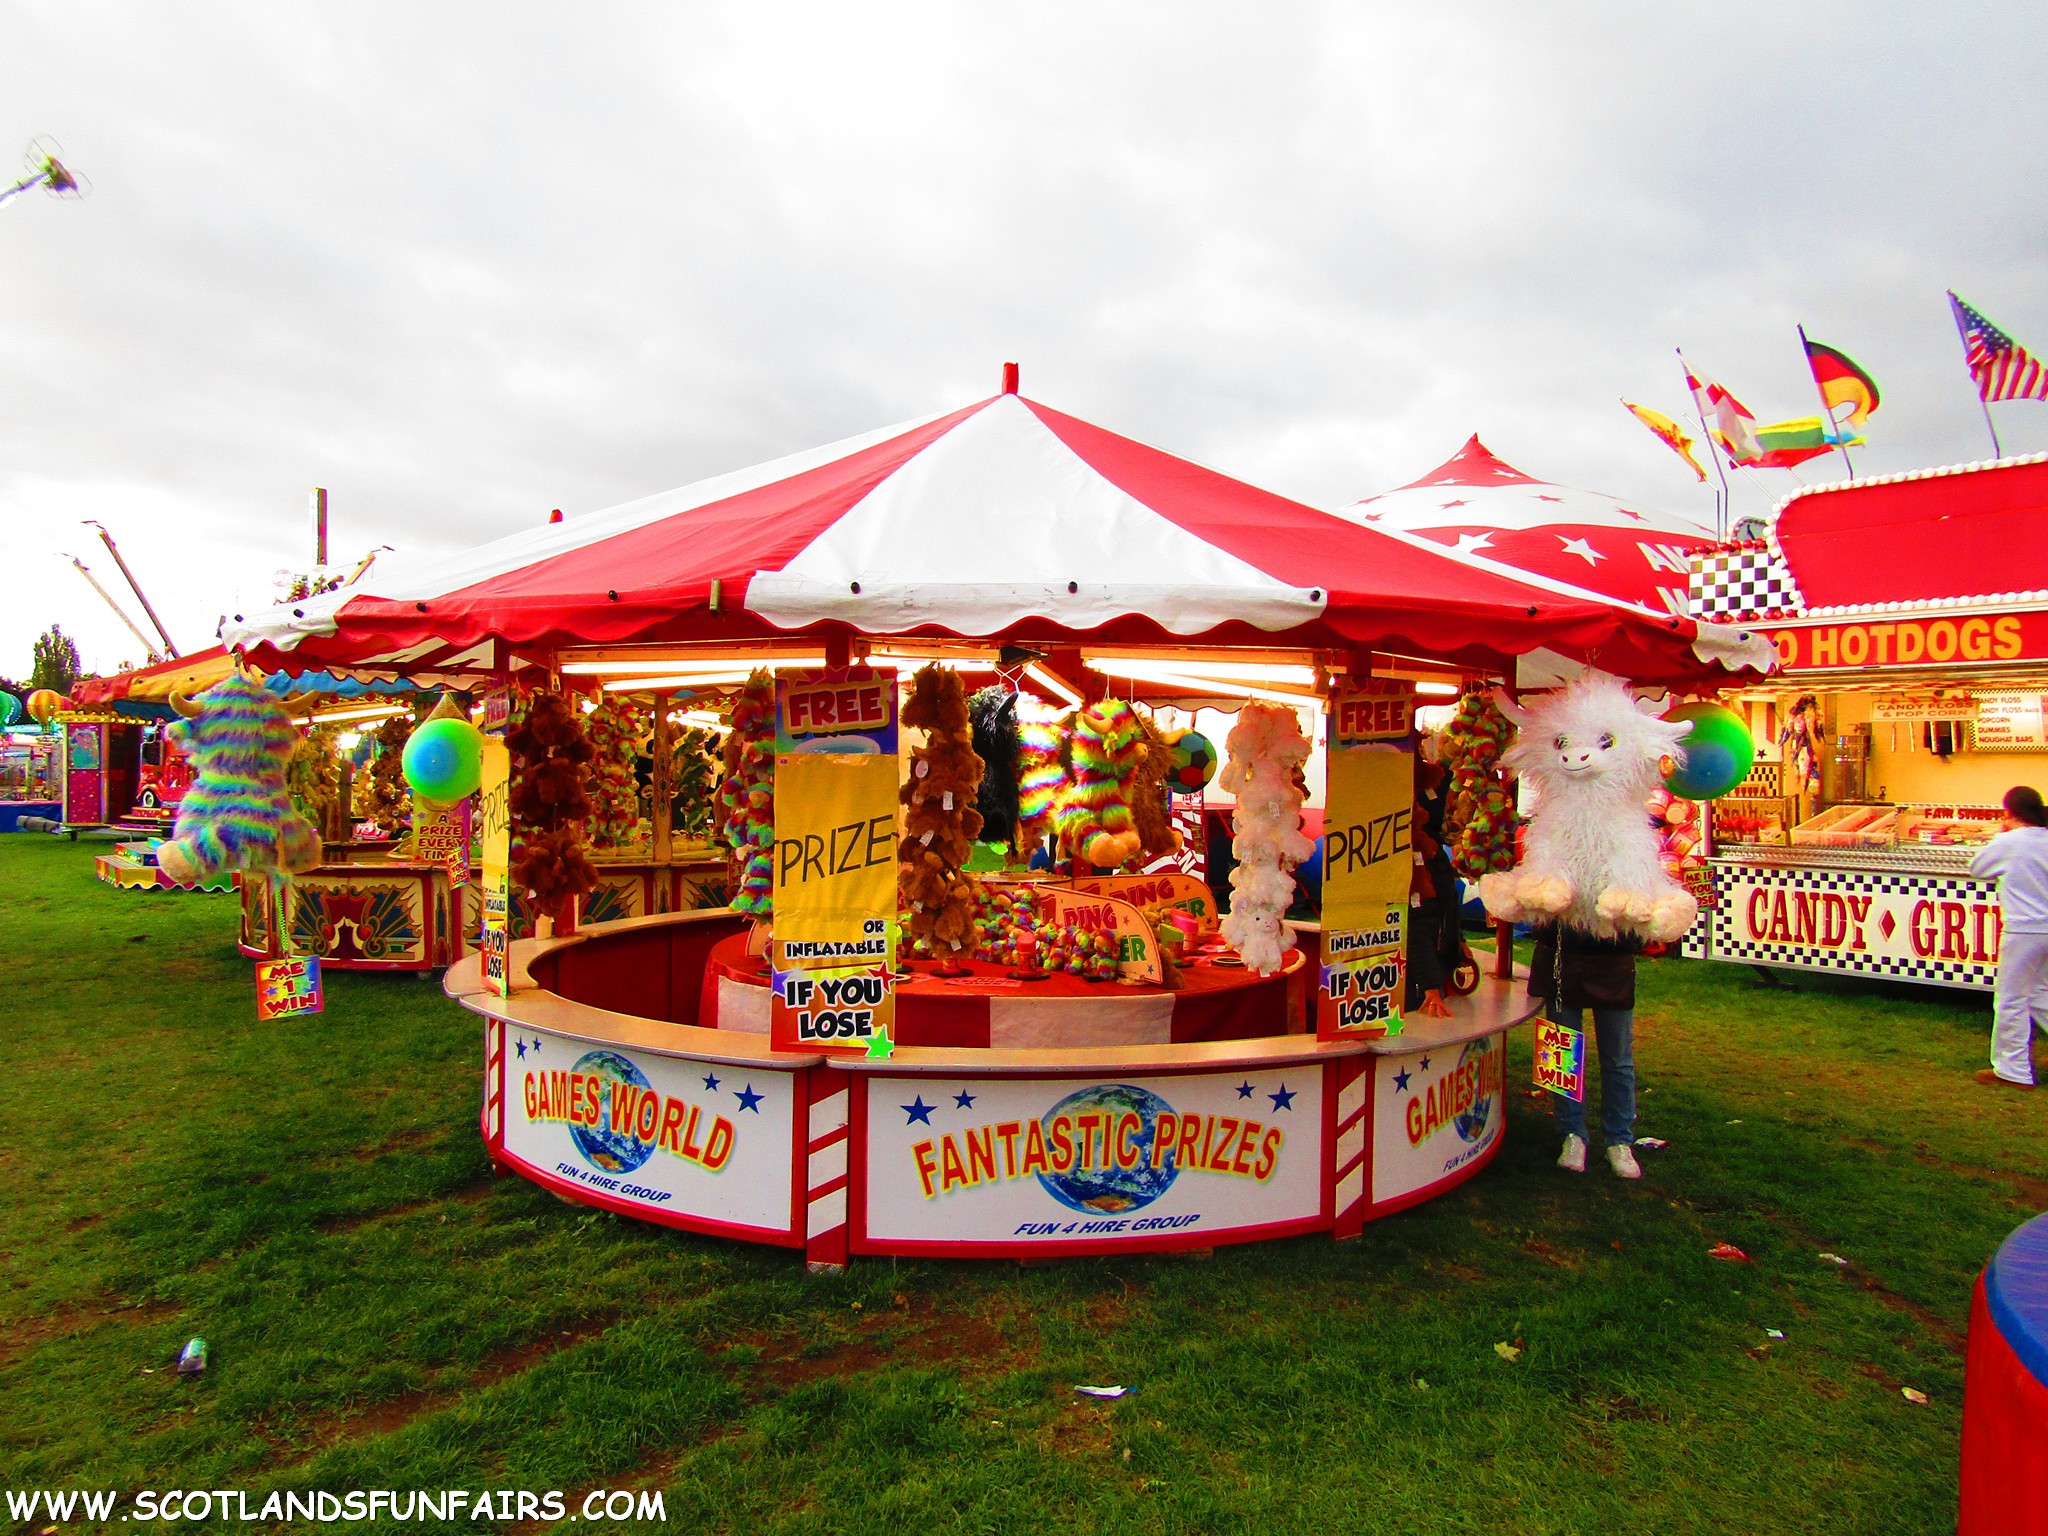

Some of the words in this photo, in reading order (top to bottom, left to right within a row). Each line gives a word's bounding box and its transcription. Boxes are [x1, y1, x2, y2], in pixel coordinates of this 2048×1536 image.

[1811, 617, 2022, 666] HOTDOGS
[788, 686, 884, 728] FREE
[1340, 700, 1405, 733] FREE
[1877, 703, 1925, 711] CANDY
[1928, 701, 1974, 709] FLOSS
[1925, 709, 1967, 717] CORN
[419, 825, 463, 836] PRIZE
[437, 814, 448, 823] A
[418, 837, 466, 847] EVERY
[780, 814, 894, 888] PRIZE
[1325, 808, 1411, 881] PRIZE
[1685, 871, 1700, 881] ME
[1703, 870, 1714, 880] IF
[1689, 883, 1711, 894] YOU
[863, 920, 884, 934] OR
[1385, 911, 1400, 925] OR
[1747, 887, 1872, 951] CANDY
[492, 930, 505, 954] YOU
[786, 939, 886, 958] INFLATABLE
[1330, 929, 1400, 952] INFLATABLE
[269, 961, 305, 979] ME
[487, 955, 502, 979] LOSE
[283, 980, 295, 993] 1
[786, 980, 814, 1006] IF
[820, 977, 882, 1005] YOU
[1330, 971, 1350, 998] IF
[1354, 964, 1397, 993] YOU
[264, 991, 317, 1015] WIN
[1339, 995, 1390, 1027] LOSE
[799, 1011, 872, 1039] LOSE
[1543, 1028, 1572, 1049] ME
[1552, 1051, 1562, 1066] 1
[1537, 1066, 1578, 1091] WIN
[1406, 1060, 1475, 1147] GAMES
[523, 1069, 602, 1127] GAMES
[609, 1080, 735, 1171] WORLD
[911, 1113, 1141, 1199] FANTASTIC
[1152, 1112, 1283, 1184] PRIZES
[555, 1162, 580, 1180] FUN
[579, 1171, 588, 1182] 4
[588, 1173, 620, 1191] HIRE
[620, 1183, 672, 1203] GROUP
[1013, 1221, 1060, 1236] FUN
[1061, 1221, 1076, 1235] 4
[1078, 1219, 1128, 1234] HIRE
[1132, 1213, 1201, 1232] GROUP
